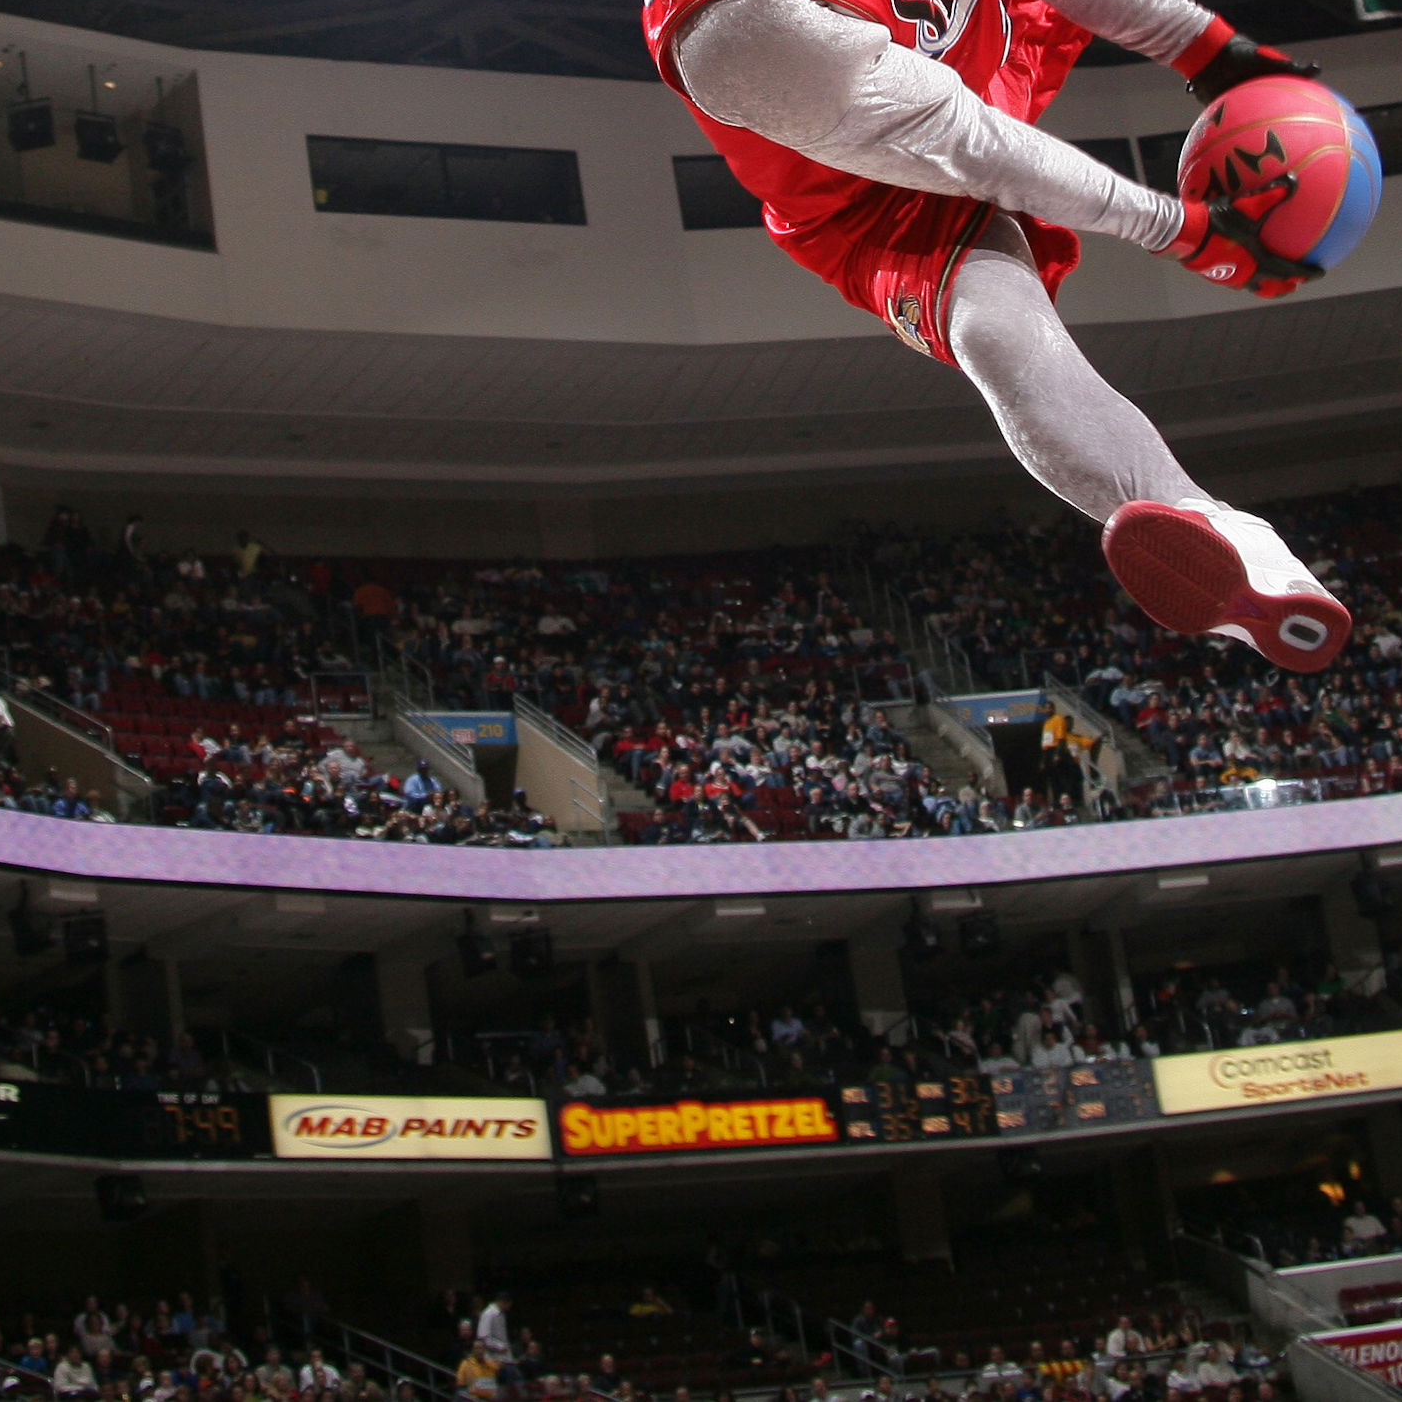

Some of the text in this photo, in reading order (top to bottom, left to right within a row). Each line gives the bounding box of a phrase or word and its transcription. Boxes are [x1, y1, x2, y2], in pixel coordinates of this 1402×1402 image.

[1241, 1071, 1370, 1099] SportsNet
[293, 1115, 537, 1140] MAB PAINTS
